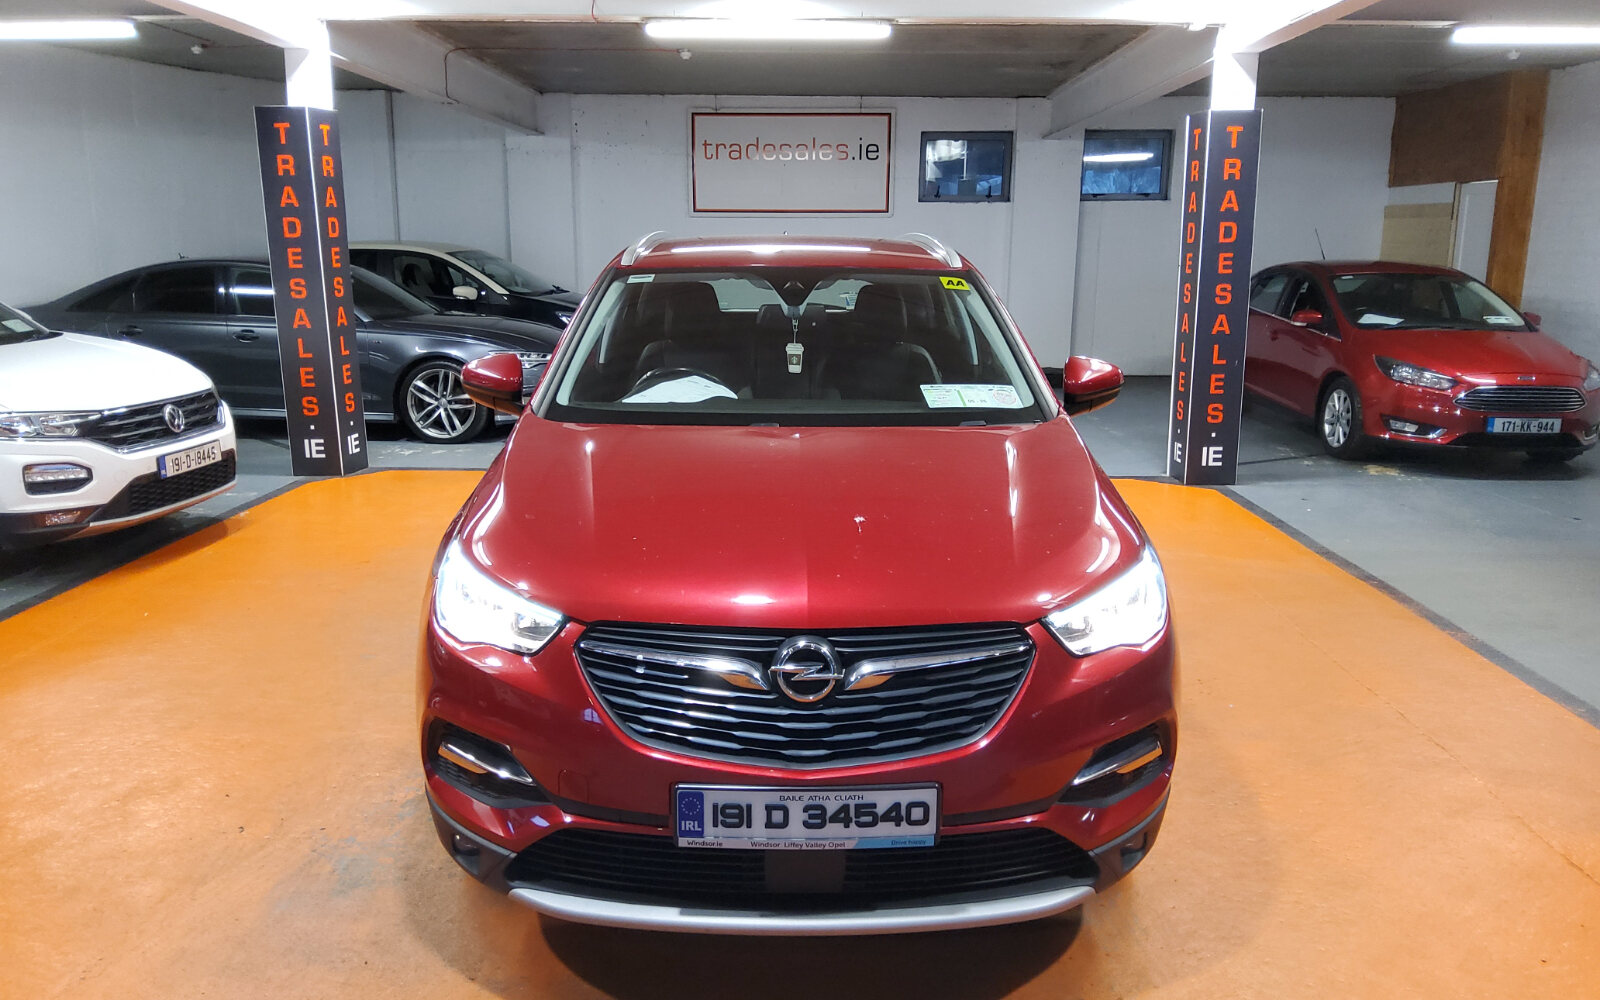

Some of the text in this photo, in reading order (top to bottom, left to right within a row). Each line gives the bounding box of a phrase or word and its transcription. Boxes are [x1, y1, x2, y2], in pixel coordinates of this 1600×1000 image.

[702, 136, 880, 161] tradesales.ie
[946, 279, 965, 287] AA
[1501, 421, 1555, 433] 171-KK-944
[171, 446, 217, 473] 191-D-18445
[807, 794, 831, 802] ATHA
[834, 793, 864, 801] CLIATH
[712, 801, 930, 830] 191 D 34540
[681, 820, 702, 831] IRL
[784, 841, 803, 849] Liffey
[805, 841, 826, 849] Valley
[828, 841, 846, 849] Opel
